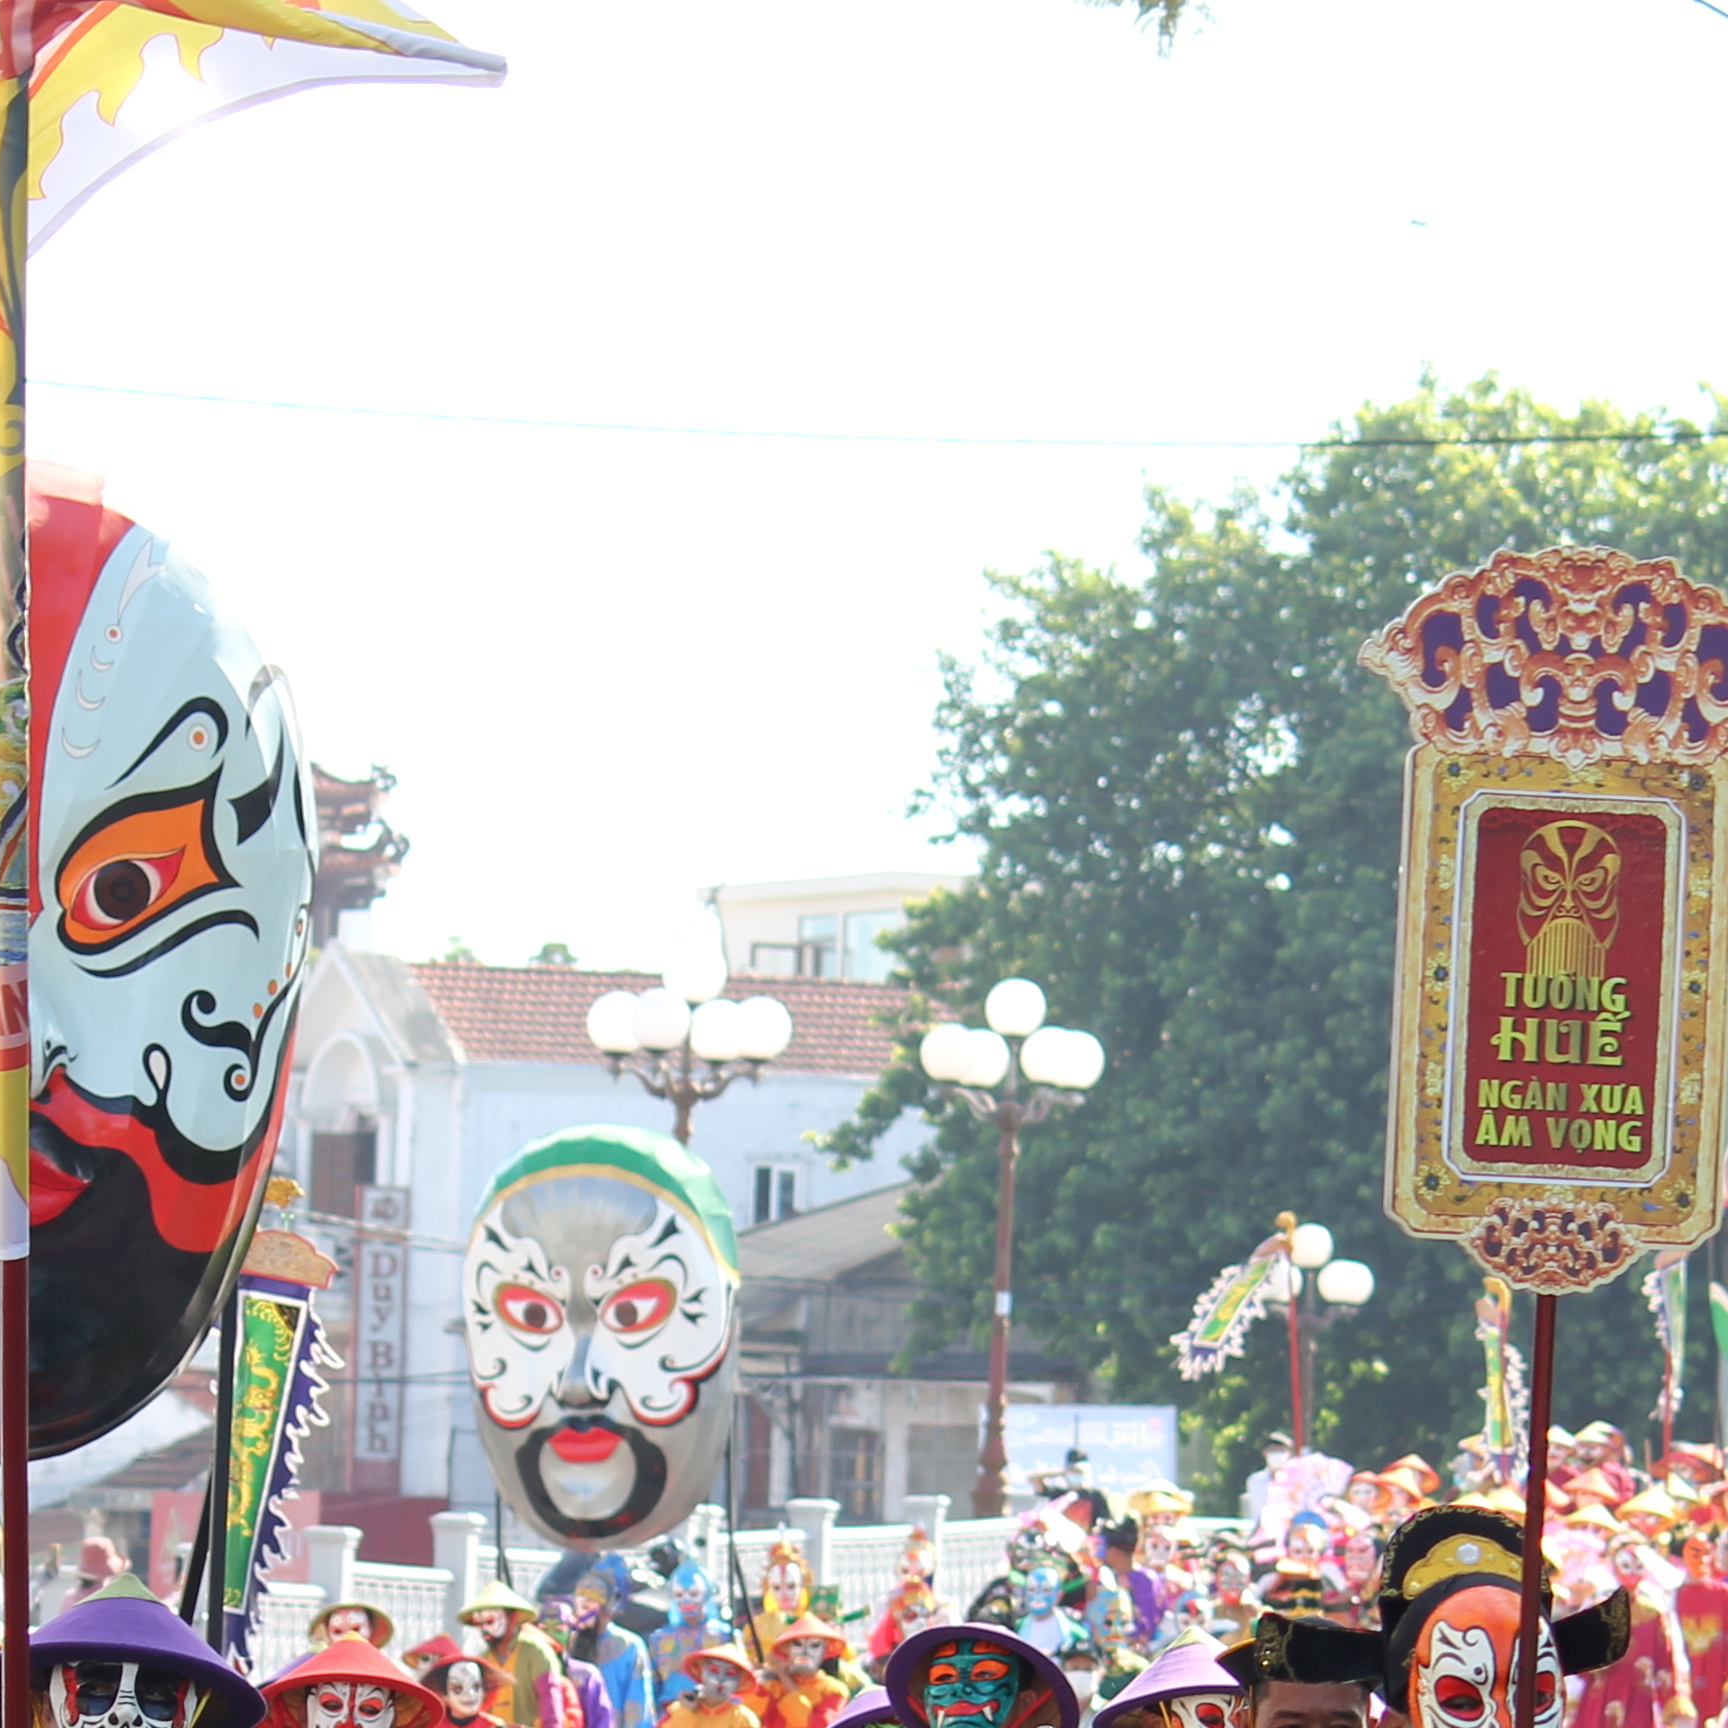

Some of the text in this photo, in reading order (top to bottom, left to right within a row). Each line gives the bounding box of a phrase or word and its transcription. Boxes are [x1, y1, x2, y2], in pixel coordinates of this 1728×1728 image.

[1490, 1011, 1632, 1066] HUẾ
[1478, 1076, 1645, 1115] NGÀN XƯA
[1474, 1109, 1643, 1154] ÂM VỌNG
